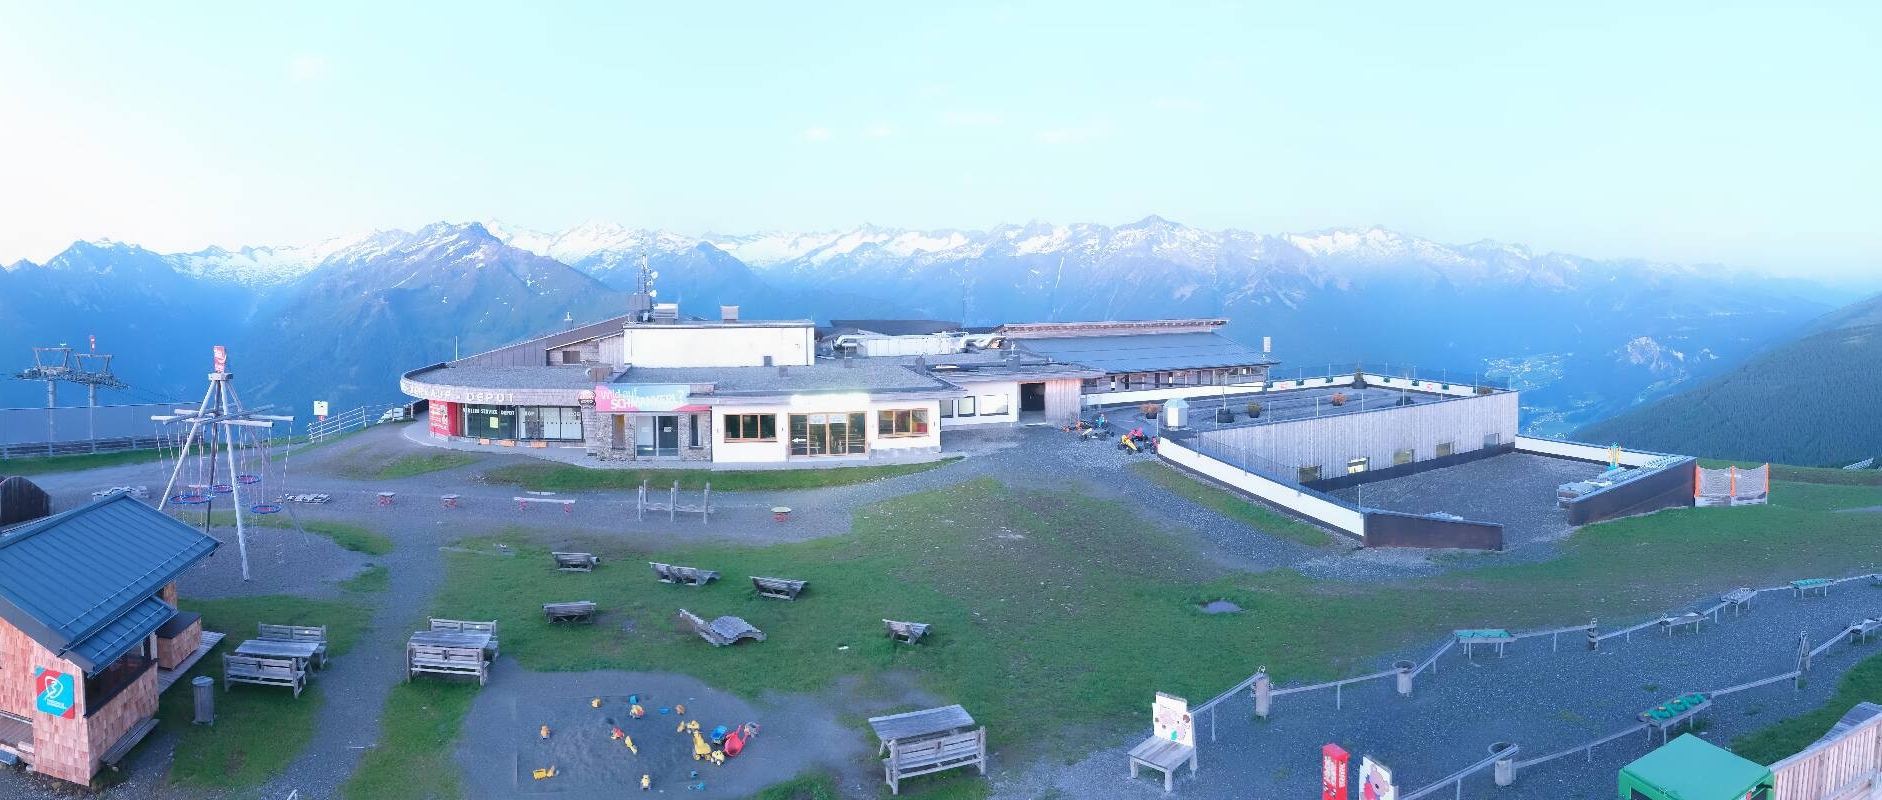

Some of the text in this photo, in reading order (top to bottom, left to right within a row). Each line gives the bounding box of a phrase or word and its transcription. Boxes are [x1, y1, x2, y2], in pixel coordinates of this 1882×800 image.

[467, 392, 515, 402] DEPOT
[602, 388, 637, 399] Wild auf
